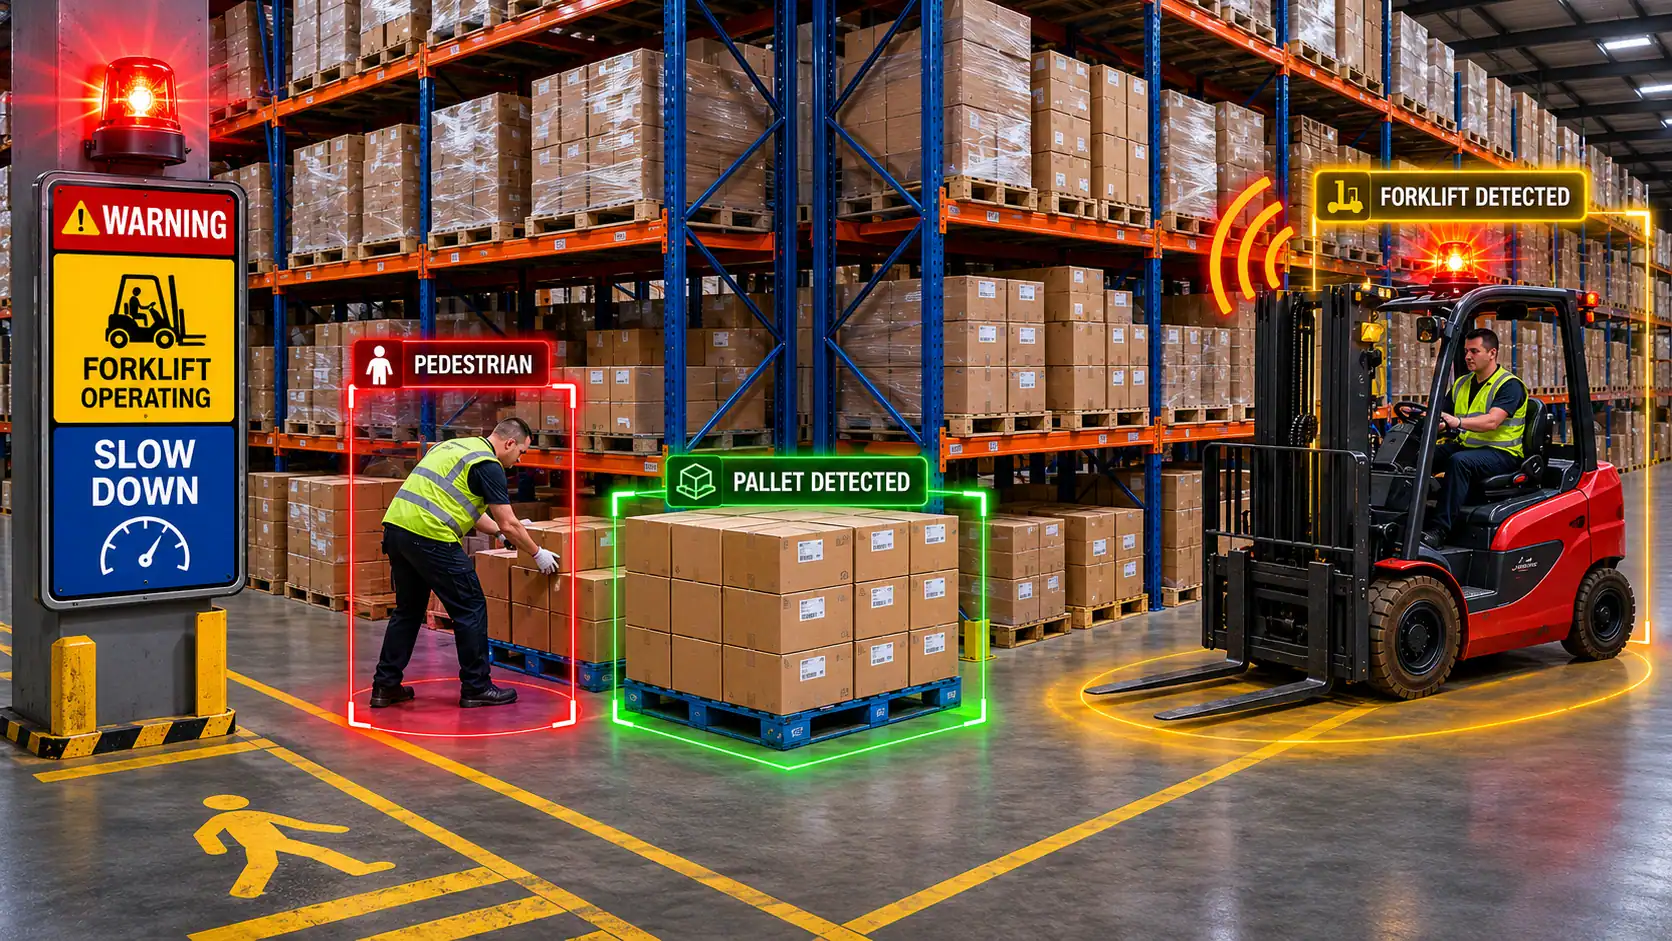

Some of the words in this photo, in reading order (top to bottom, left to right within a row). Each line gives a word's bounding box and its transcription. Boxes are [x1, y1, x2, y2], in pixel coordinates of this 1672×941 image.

[103, 204, 227, 240] WARNING
[83, 356, 212, 381] FORKLIFT
[81, 387, 211, 409] OPERATING
[94, 438, 196, 470] SLOW
[92, 476, 198, 507] DOWN
